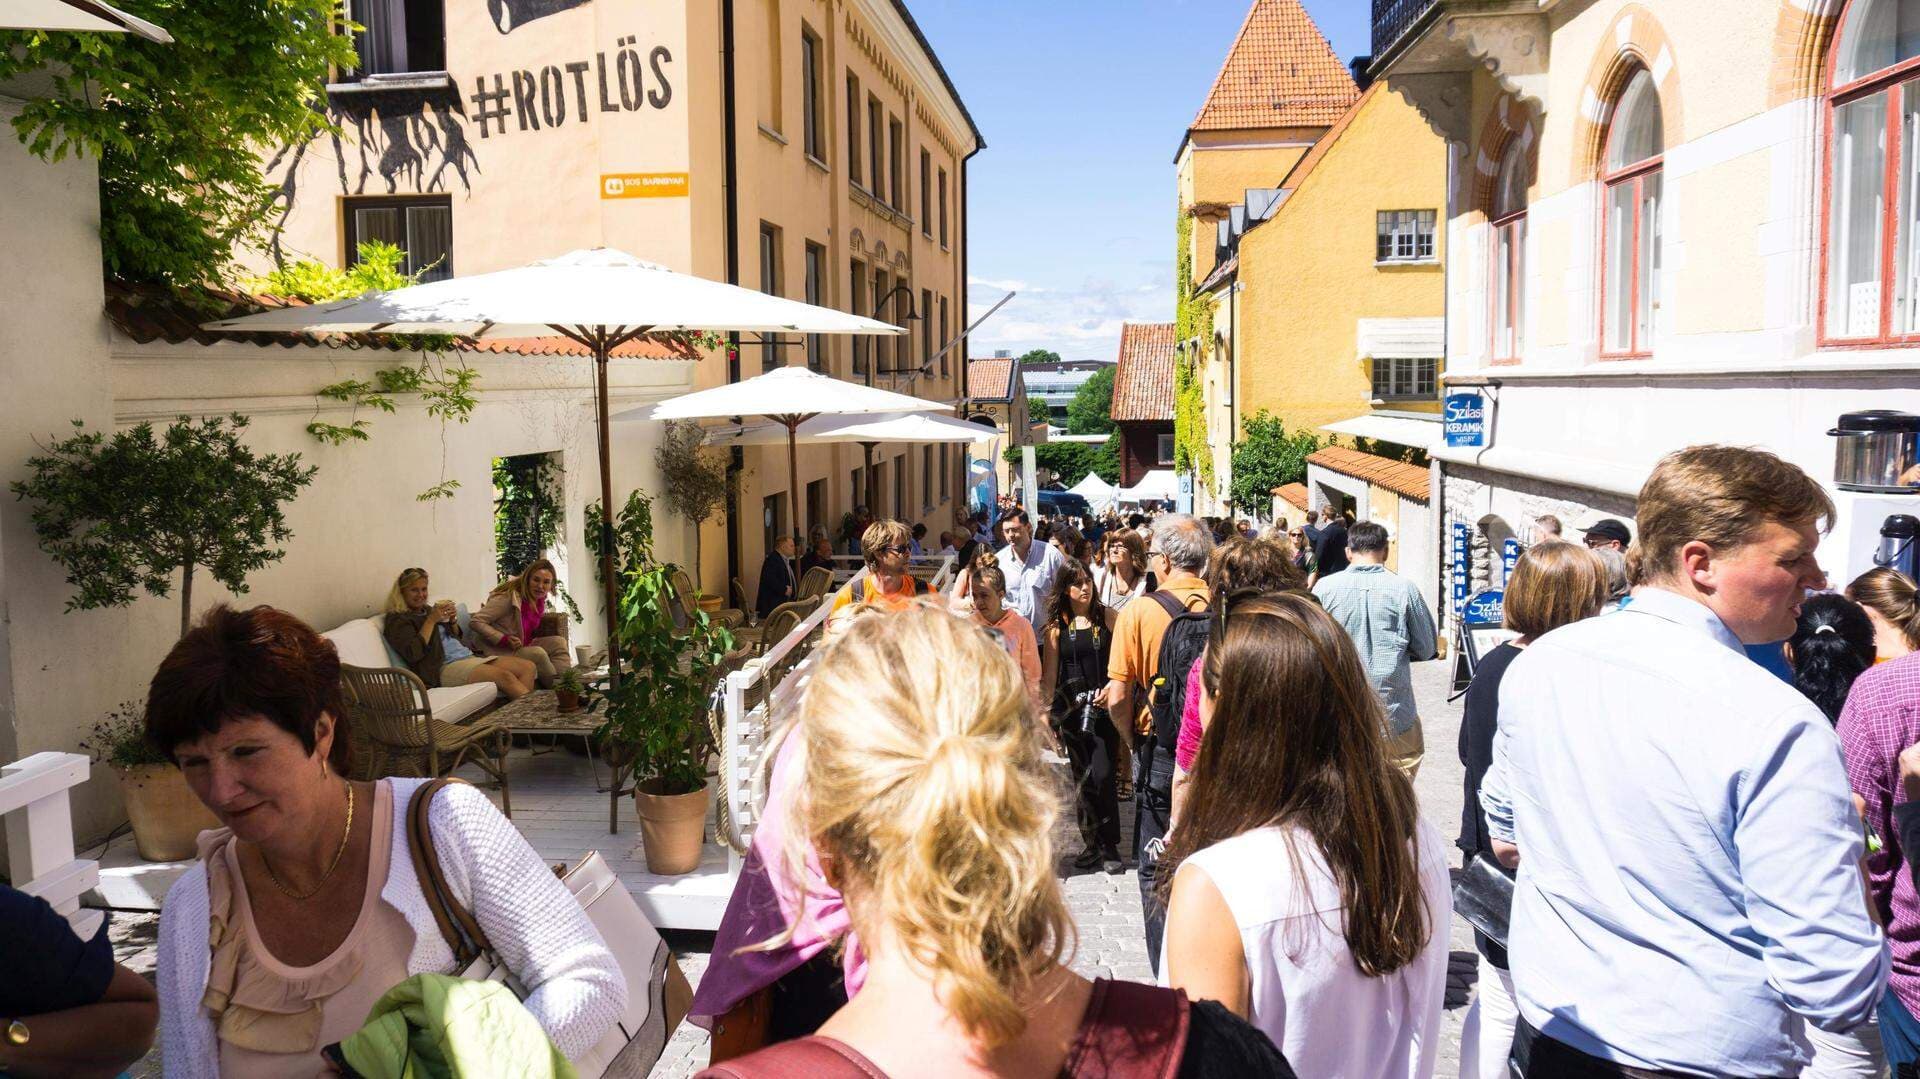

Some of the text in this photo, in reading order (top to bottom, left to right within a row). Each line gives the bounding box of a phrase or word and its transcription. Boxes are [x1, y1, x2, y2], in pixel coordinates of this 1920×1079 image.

[470, 35, 673, 138] #ROTLÖS
[624, 179, 641, 187] SOS
[1446, 422, 1486, 433] KERAMIK
[1455, 528, 1465, 608] KERAMIK
[1469, 598, 1503, 615] Szila
